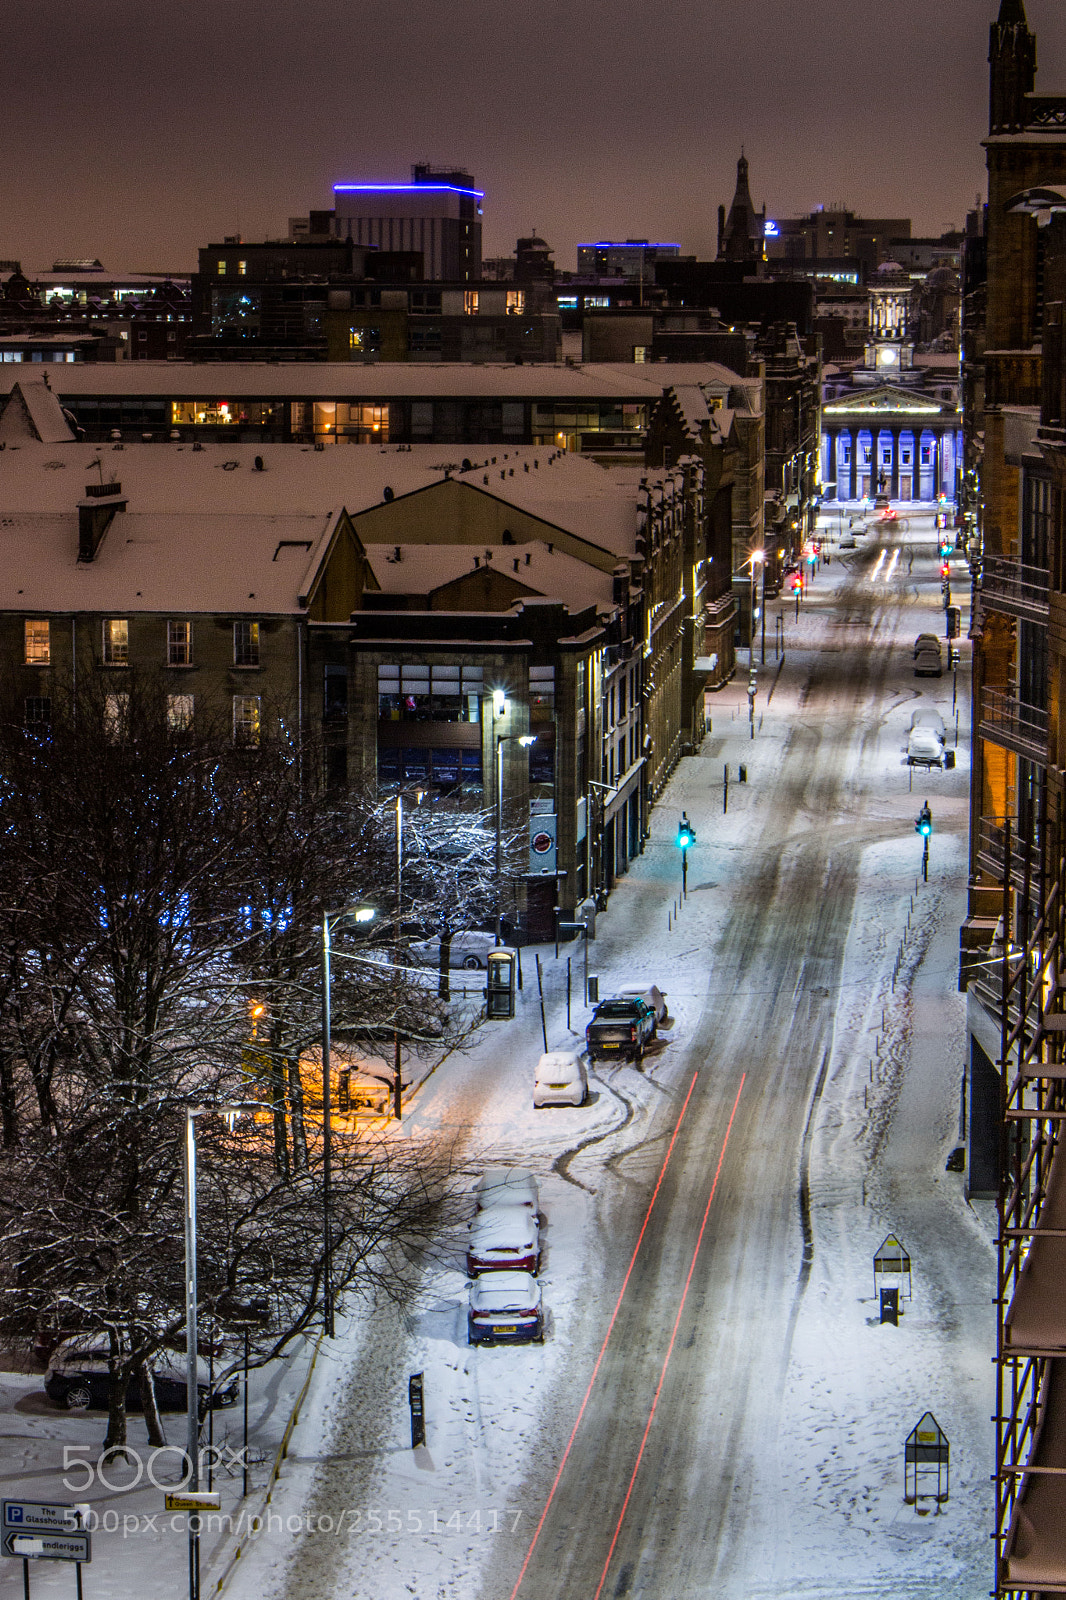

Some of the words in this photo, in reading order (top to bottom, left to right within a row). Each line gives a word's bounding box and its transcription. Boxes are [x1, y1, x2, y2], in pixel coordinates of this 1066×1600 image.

[41, 1508, 56, 1516] The
[25, 1515, 72, 1525] Glasshouse
[42, 1541, 84, 1552] andleriggs
